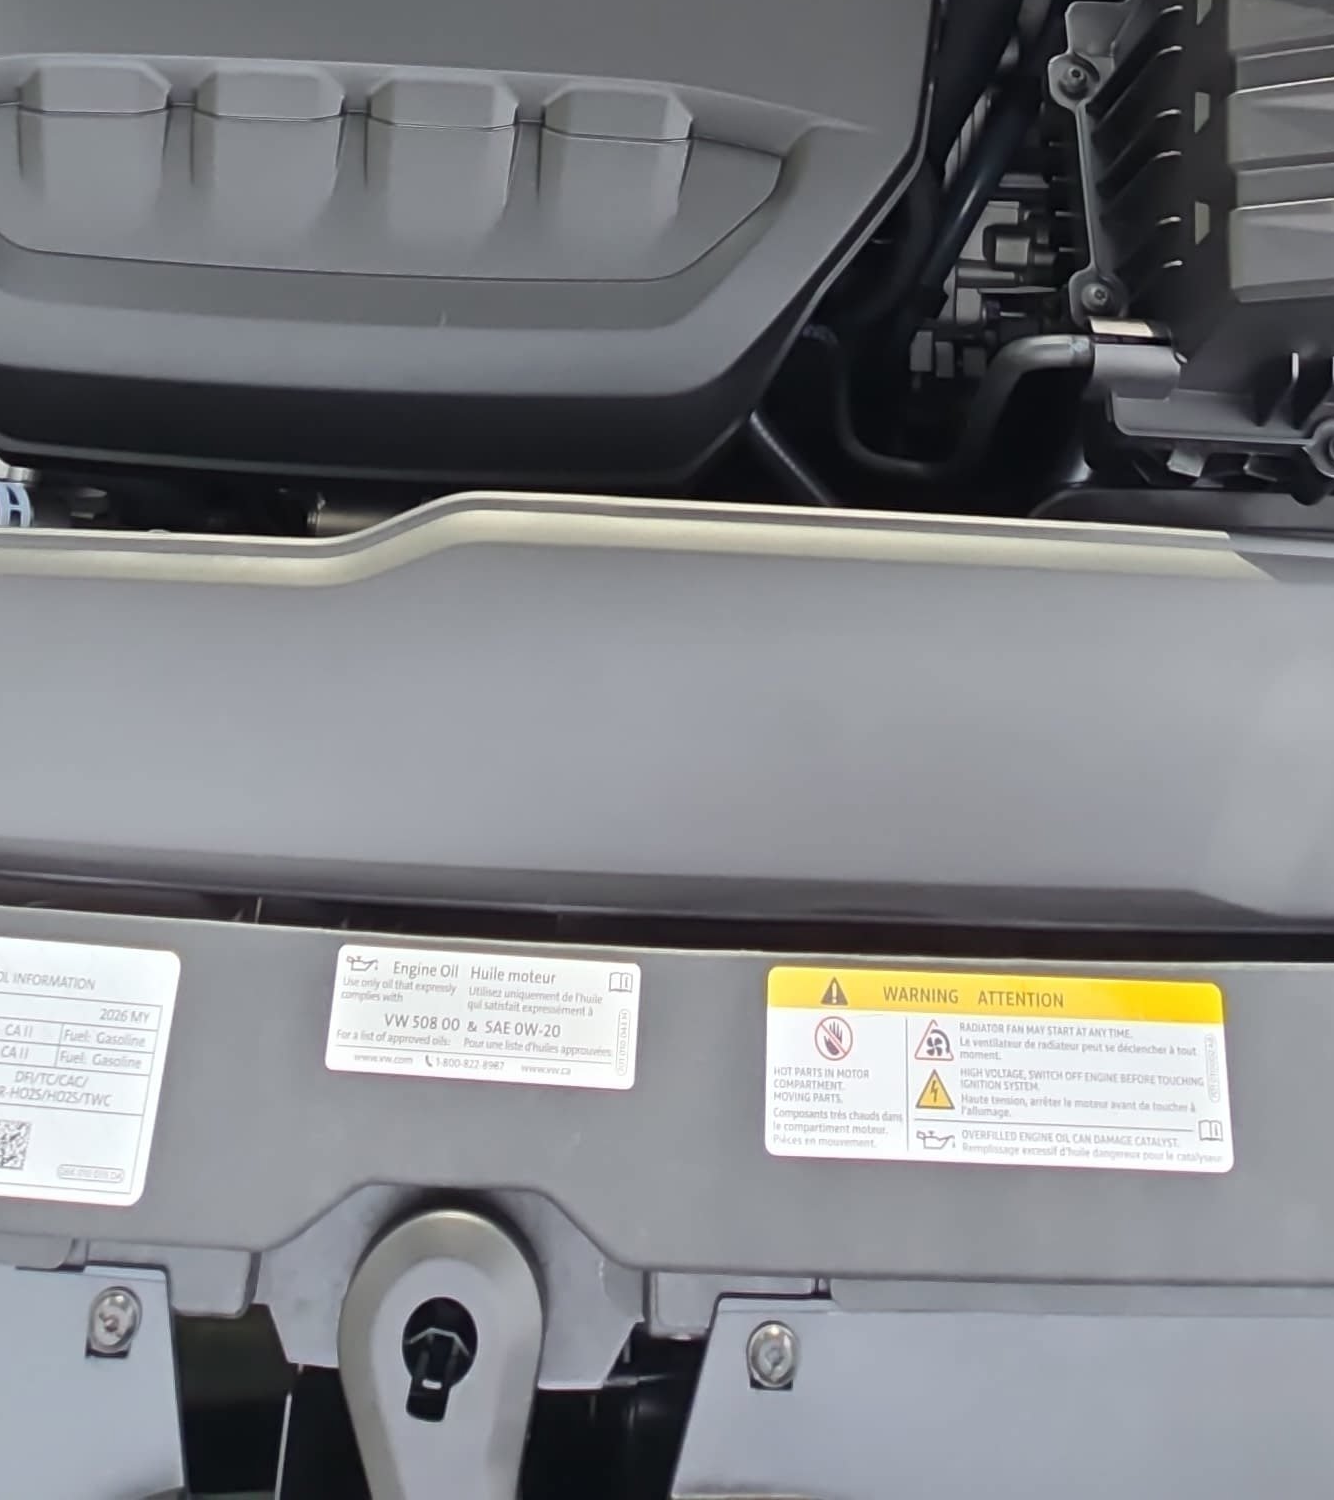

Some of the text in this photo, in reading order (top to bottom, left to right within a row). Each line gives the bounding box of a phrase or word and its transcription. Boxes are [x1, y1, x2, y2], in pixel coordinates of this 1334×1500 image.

[393, 961, 459, 979] Engine Oil
[470, 966, 556, 984] Huile moteur
[13, 972, 96, 990] INFORMATION
[343, 977, 360, 987] Use
[361, 978, 380, 991] only
[395, 981, 413, 991] that
[415, 983, 457, 996] expressly
[341, 991, 403, 1003] complies with
[469, 986, 502, 998] Utilisez
[504, 989, 560, 1003] uniquement
[575, 994, 603, 1005] l'huile
[883, 986, 1064, 1008] WARNING ATTENTION
[99, 1008, 150, 1024] 2026 MY
[467, 1001, 482, 1013] qui
[484, 1002, 521, 1013] satisfait
[522, 1004, 586, 1017] expressément
[5, 1024, 23, 1037] CA
[384, 1013, 561, 1038] VW 508 00 & SAE 0W-20
[960, 1022, 1004, 1034] RADIATOR
[1007, 1024, 1024, 1035] FAN
[1027, 1025, 1045, 1036] MAY
[1048, 1026, 1074, 1037] START
[1088, 1028, 1107, 1038] ANY
[63, 1029, 146, 1047] Fuel: Gasoline
[336, 1029, 351, 1039] For
[388, 1034, 431, 1046] approved
[463, 1037, 484, 1049] Pour
[485, 1041, 504, 1050] une
[505, 1039, 523, 1052] liste
[0, 1045, 17, 1059] CA
[973, 1038, 1021, 1048] ventilateur
[1038, 1040, 1079, 1051] radiateur
[1082, 1043, 1102, 1054] peut
[1117, 1043, 1167, 1055] déclencher
[1177, 1046, 1196, 1056] tout
[60, 1051, 142, 1069] Fuel: Gasoline
[773, 1066, 792, 1077] HOT
[794, 1067, 822, 1078] PARTS
[837, 1069, 869, 1079] MOTOR
[960, 1068, 983, 1078] HIGH
[1029, 1070, 1063, 1080] SWITCH
[1065, 1071, 1083, 1081] OFF
[1085, 1072, 1118, 1082] ENGINE
[1121, 1073, 1156, 1085] BEFORE
[1158, 1075, 1204, 1086] TOUCHING
[961, 1079, 1002, 1090] IGNITION
[773, 1092, 811, 1102] MOVING
[961, 1093, 989, 1104] Haute
[1030, 1096, 1061, 1108] arrêter
[1074, 1100, 1108, 1110] moteur
[1110, 1100, 1136, 1111] avant
[1153, 1101, 1188, 1112] toucher
[773, 1107, 904, 1122] Composants très chauds dans
[784, 1123, 851, 1135] compartiment
[962, 1130, 1017, 1142] OVERFILLED
[1019, 1132, 1053, 1143] ENGINE
[1055, 1133, 1071, 1143] OIL
[1072, 1134, 1091, 1145] CAN
[1093, 1134, 1133, 1146] DAMAGE
[962, 1143, 1020, 1156] Remplissage
[1022, 1145, 1058, 1157] excessif
[1092, 1148, 1139, 1160] dangereux
[1142, 1151, 1164, 1162] pour
